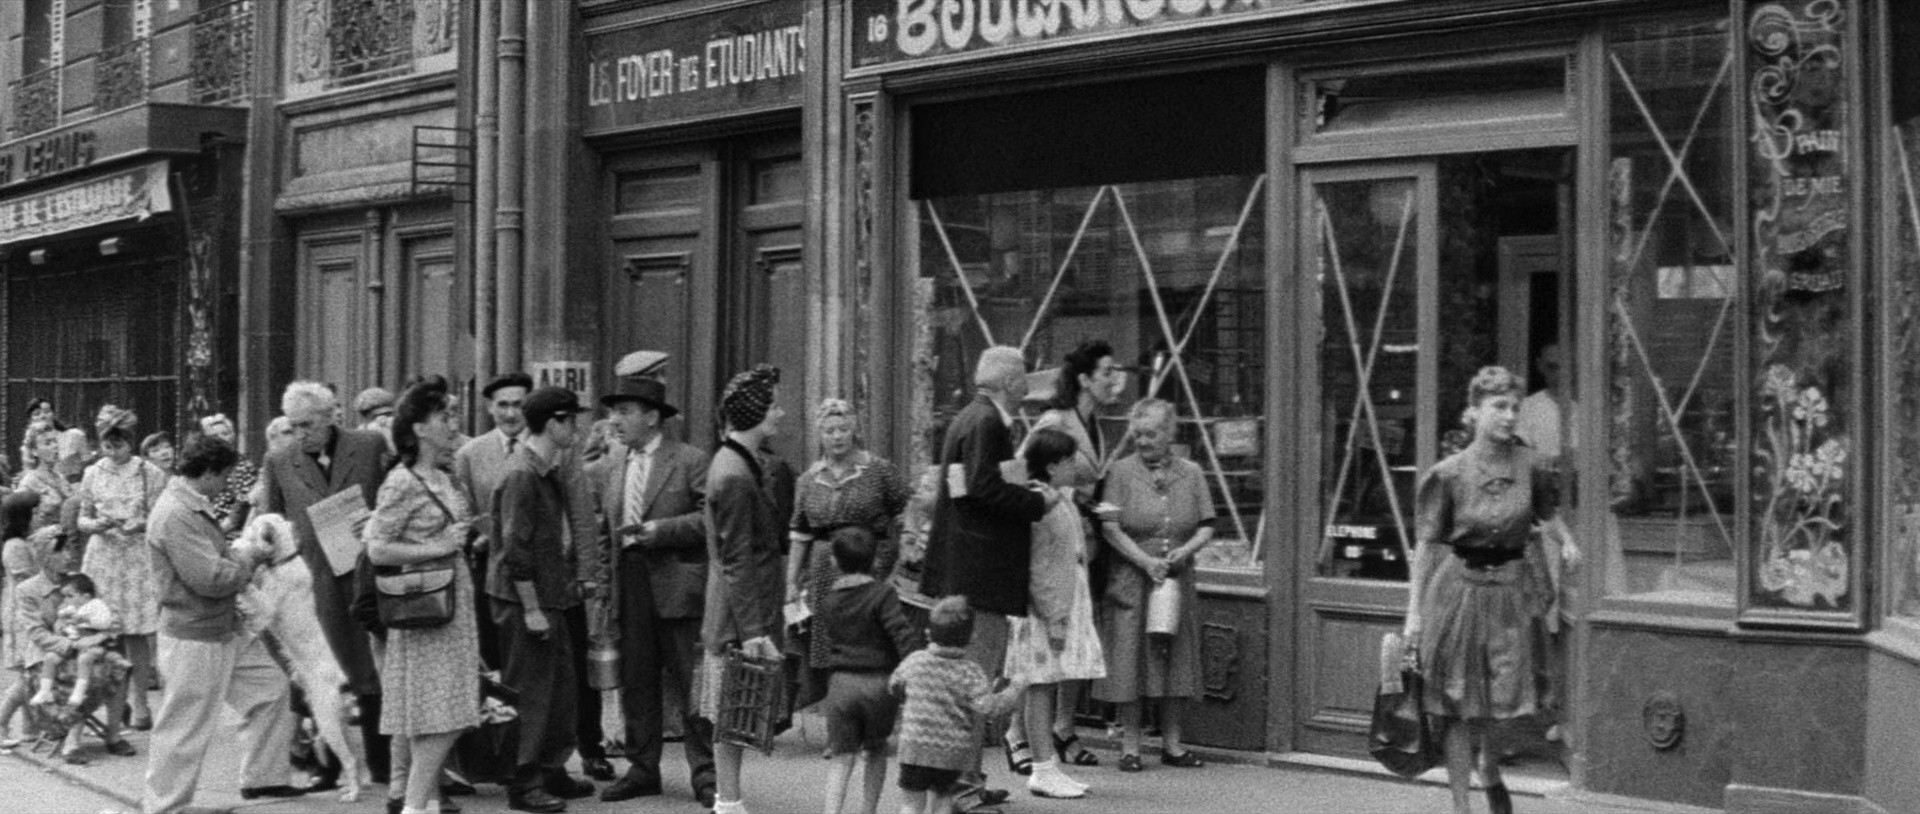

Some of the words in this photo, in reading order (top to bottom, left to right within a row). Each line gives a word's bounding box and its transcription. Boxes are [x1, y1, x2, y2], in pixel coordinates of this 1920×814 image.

[867, 14, 888, 43] 16
[616, 49, 673, 102] FOYER
[540, 367, 586, 392] ABRI
